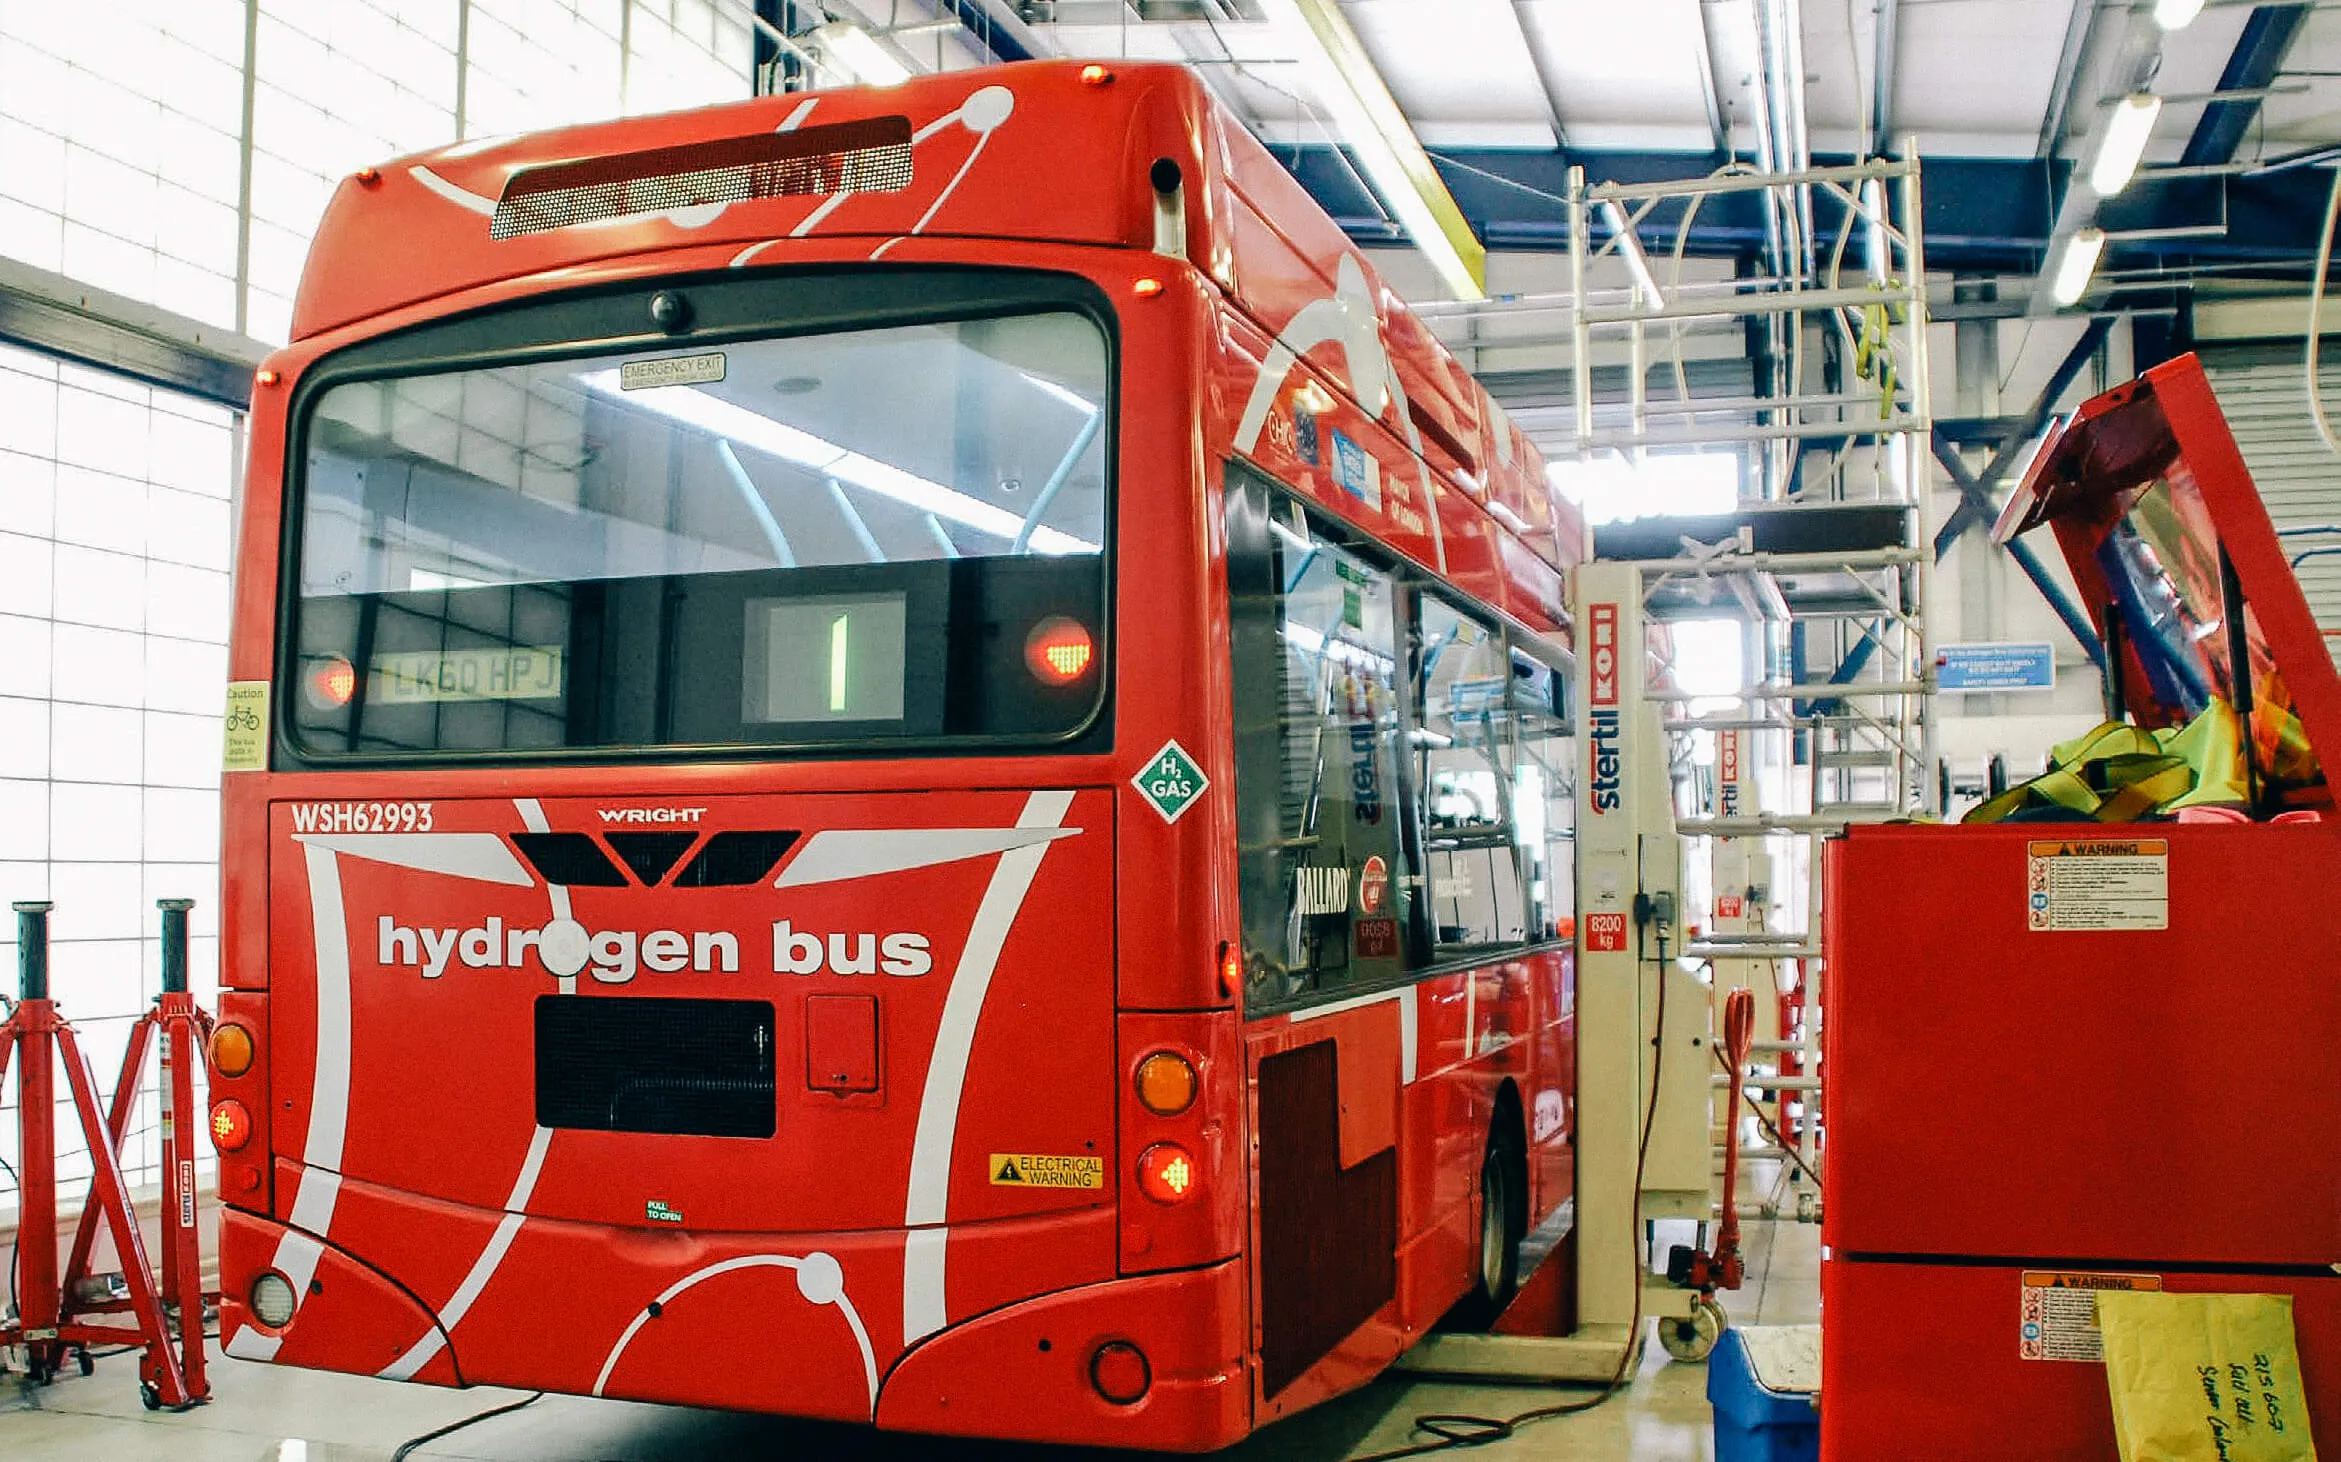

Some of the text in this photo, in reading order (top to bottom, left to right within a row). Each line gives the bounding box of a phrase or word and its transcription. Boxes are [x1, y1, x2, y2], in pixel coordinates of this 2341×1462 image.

[624, 360, 693, 378] EMERGENCY
[697, 356, 721, 370] EXIT
[395, 653, 555, 696] LK60 HPJ
[227, 688, 264, 699] Caution
[1590, 607, 1620, 815] stertil KONI
[1151, 779, 1191, 798] GAS
[291, 803, 433, 832] WSH62993
[598, 807, 707, 822] WRIGHT
[2075, 844, 2138, 856] WARNING
[1297, 867, 1348, 915] BALLARD
[1591, 916, 1622, 932] 8200
[1600, 934, 1614, 949] kg
[377, 915, 933, 984] hydrogen bus
[1020, 1157, 1101, 1172] ELECTRICAL
[1029, 1172, 1092, 1186] WARNING
[647, 1210, 682, 1221] TO OPEN
[2069, 1277, 2132, 1289] WARNING
